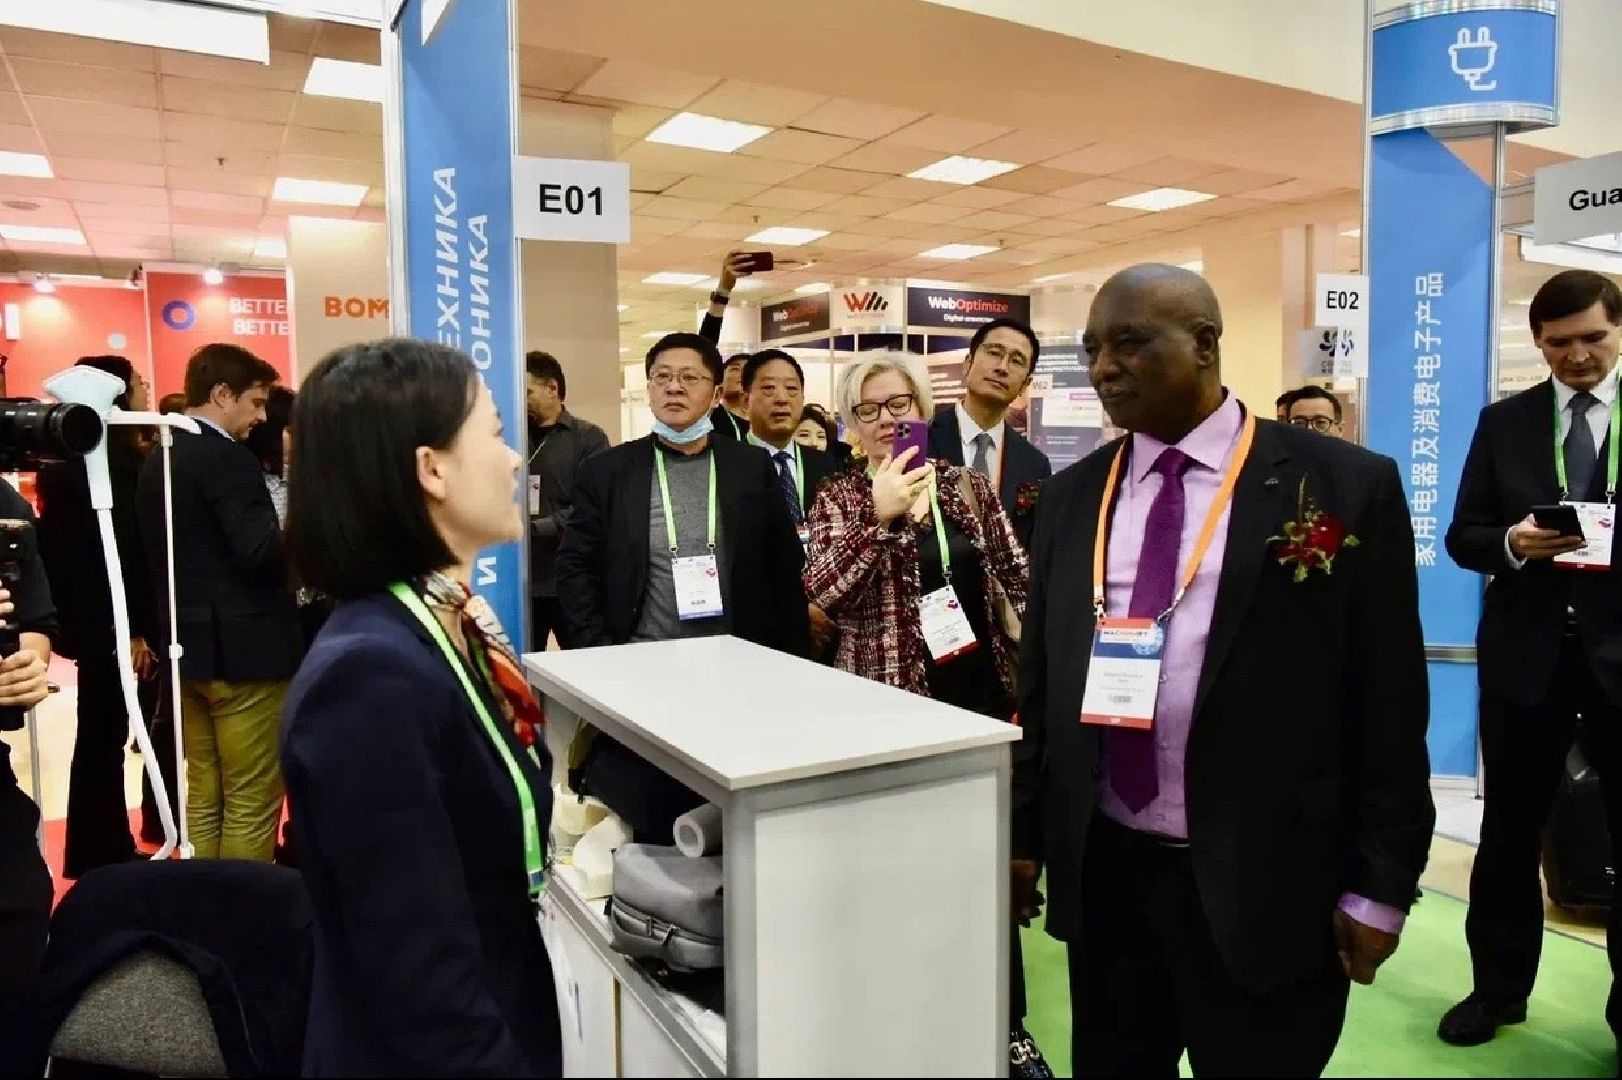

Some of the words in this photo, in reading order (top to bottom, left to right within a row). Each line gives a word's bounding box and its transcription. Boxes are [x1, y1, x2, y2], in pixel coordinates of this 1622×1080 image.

[539, 183, 604, 216] E01
[1569, 187, 1622, 211] Gua
[928, 297, 1009, 313] WebOptimize
[1326, 290, 1360, 311] E02
